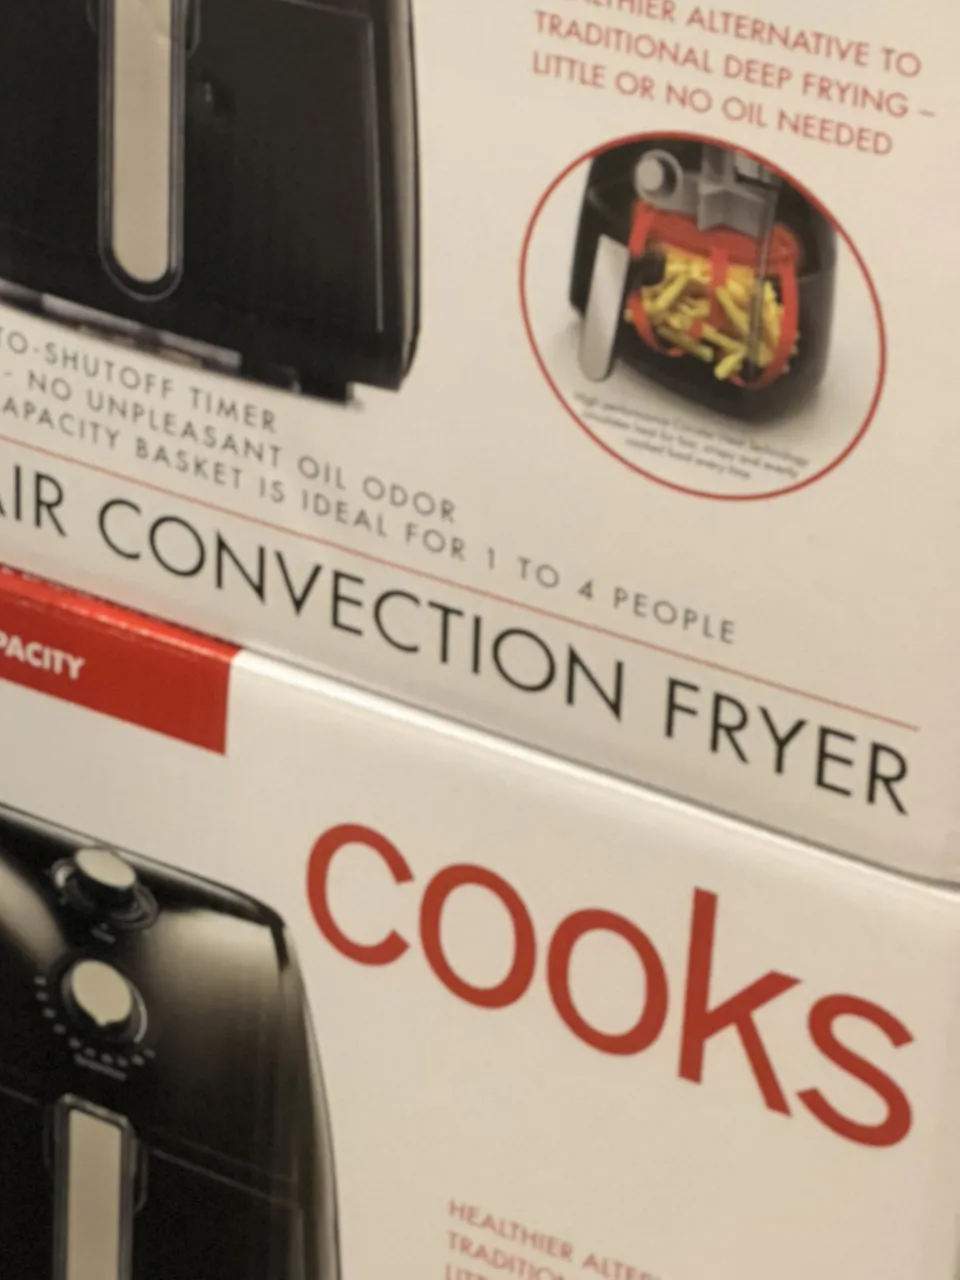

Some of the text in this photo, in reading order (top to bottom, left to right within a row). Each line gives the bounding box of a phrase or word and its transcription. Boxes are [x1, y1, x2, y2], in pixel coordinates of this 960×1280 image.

[534, 10, 713, 74] TRADITIONAL
[723, 55, 793, 90] DEEP
[802, 73, 909, 119] FRYING
[685, 6, 870, 68] ALTERNATIVE
[880, 46, 922, 79] TO
[533, 51, 893, 156] LITTLE OR NO OIL NEEDED
[28, 370, 72, 402] NO
[87, 388, 283, 469] UNPLEASANT
[297, 454, 347, 492] OIL
[362, 475, 457, 524] ODOR
[189, 385, 277, 435] TIMER
[135, 435, 243, 491] BASKET
[259, 475, 286, 504] IS
[301, 488, 389, 538] IDEAL
[404, 522, 466, 563] FOR
[486, 546, 496, 570] 1
[517, 556, 561, 590] TO
[577, 579, 596, 602] 4
[612, 586, 737, 646] PEOPLE
[98, 498, 624, 722] CONVECTION
[665, 677, 909, 816] FRYER
[305, 823, 915, 1148] cooks
[448, 1198, 573, 1263] HEALTHIER
